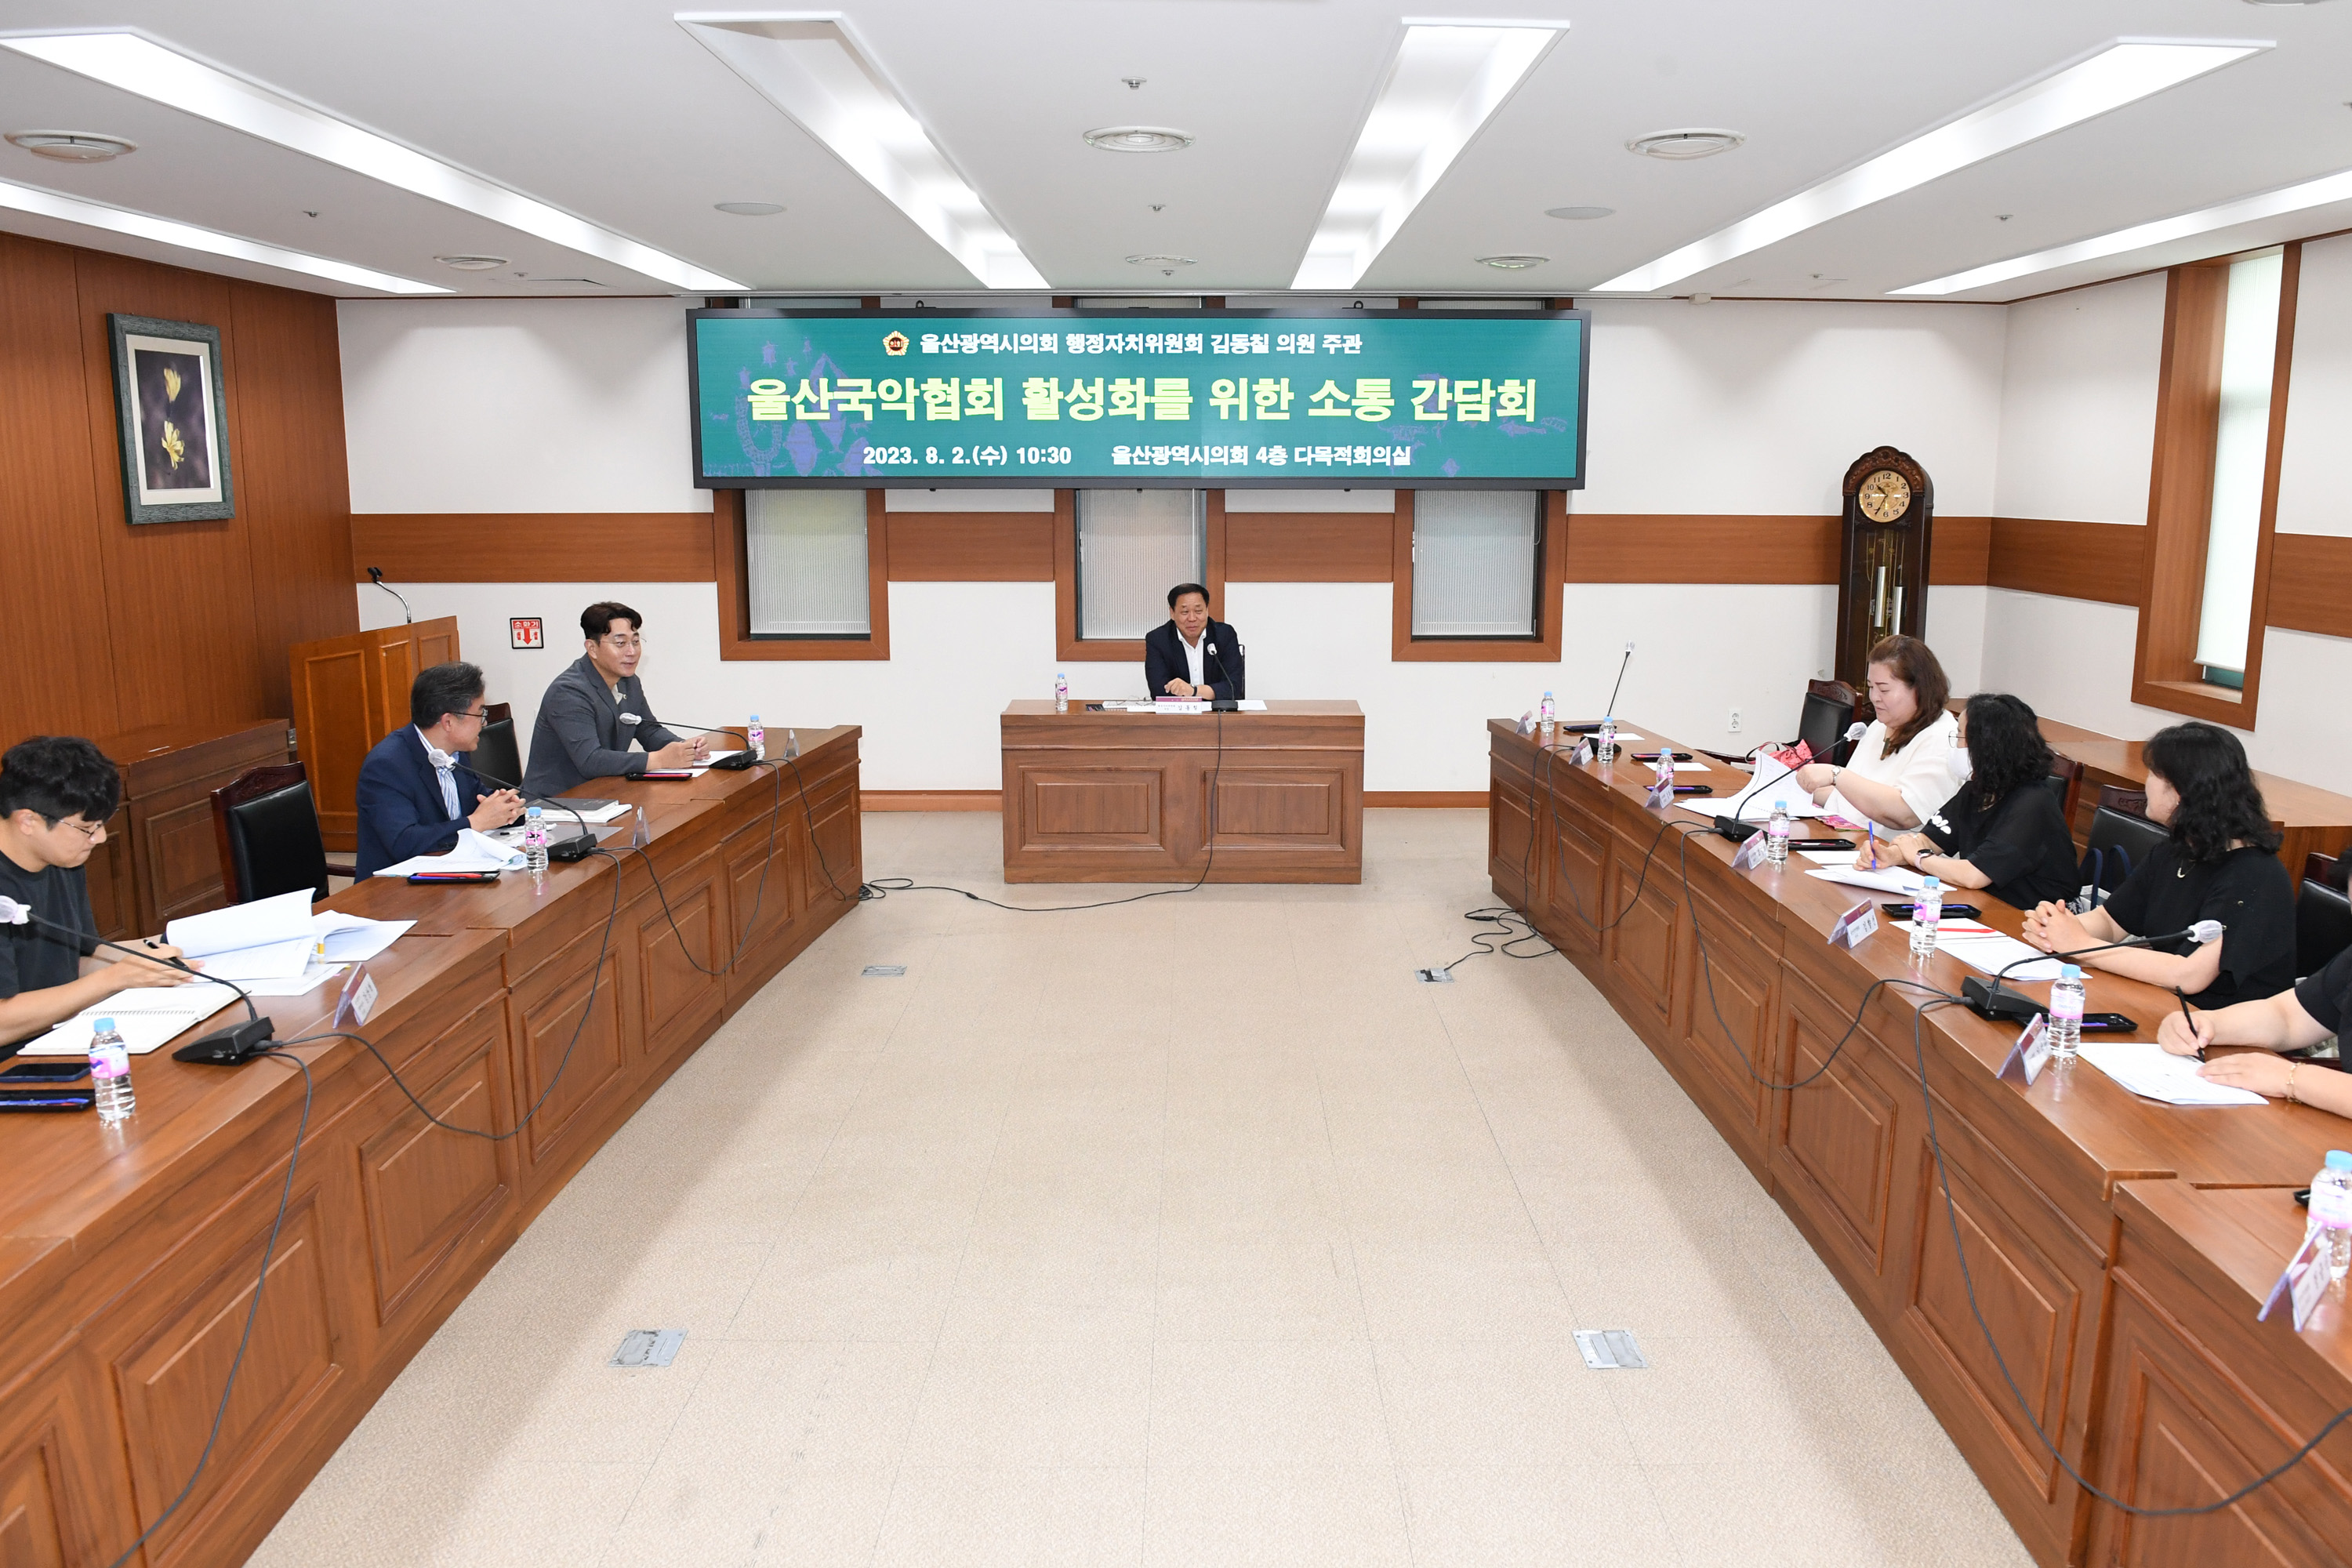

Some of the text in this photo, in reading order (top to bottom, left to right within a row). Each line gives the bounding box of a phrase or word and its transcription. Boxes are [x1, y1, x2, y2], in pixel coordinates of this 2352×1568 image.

[920, 332, 1363, 354] 울산광역시의회 행정자치위원회 김동칠 의원 주관
[747, 377, 1536, 422] 울산국악협회 활성화를 위한 소통 간담회
[863, 445, 1411, 466] 2023. 8. 2.(수) 10:30 울산광역시의회 4층 다목적회의실
